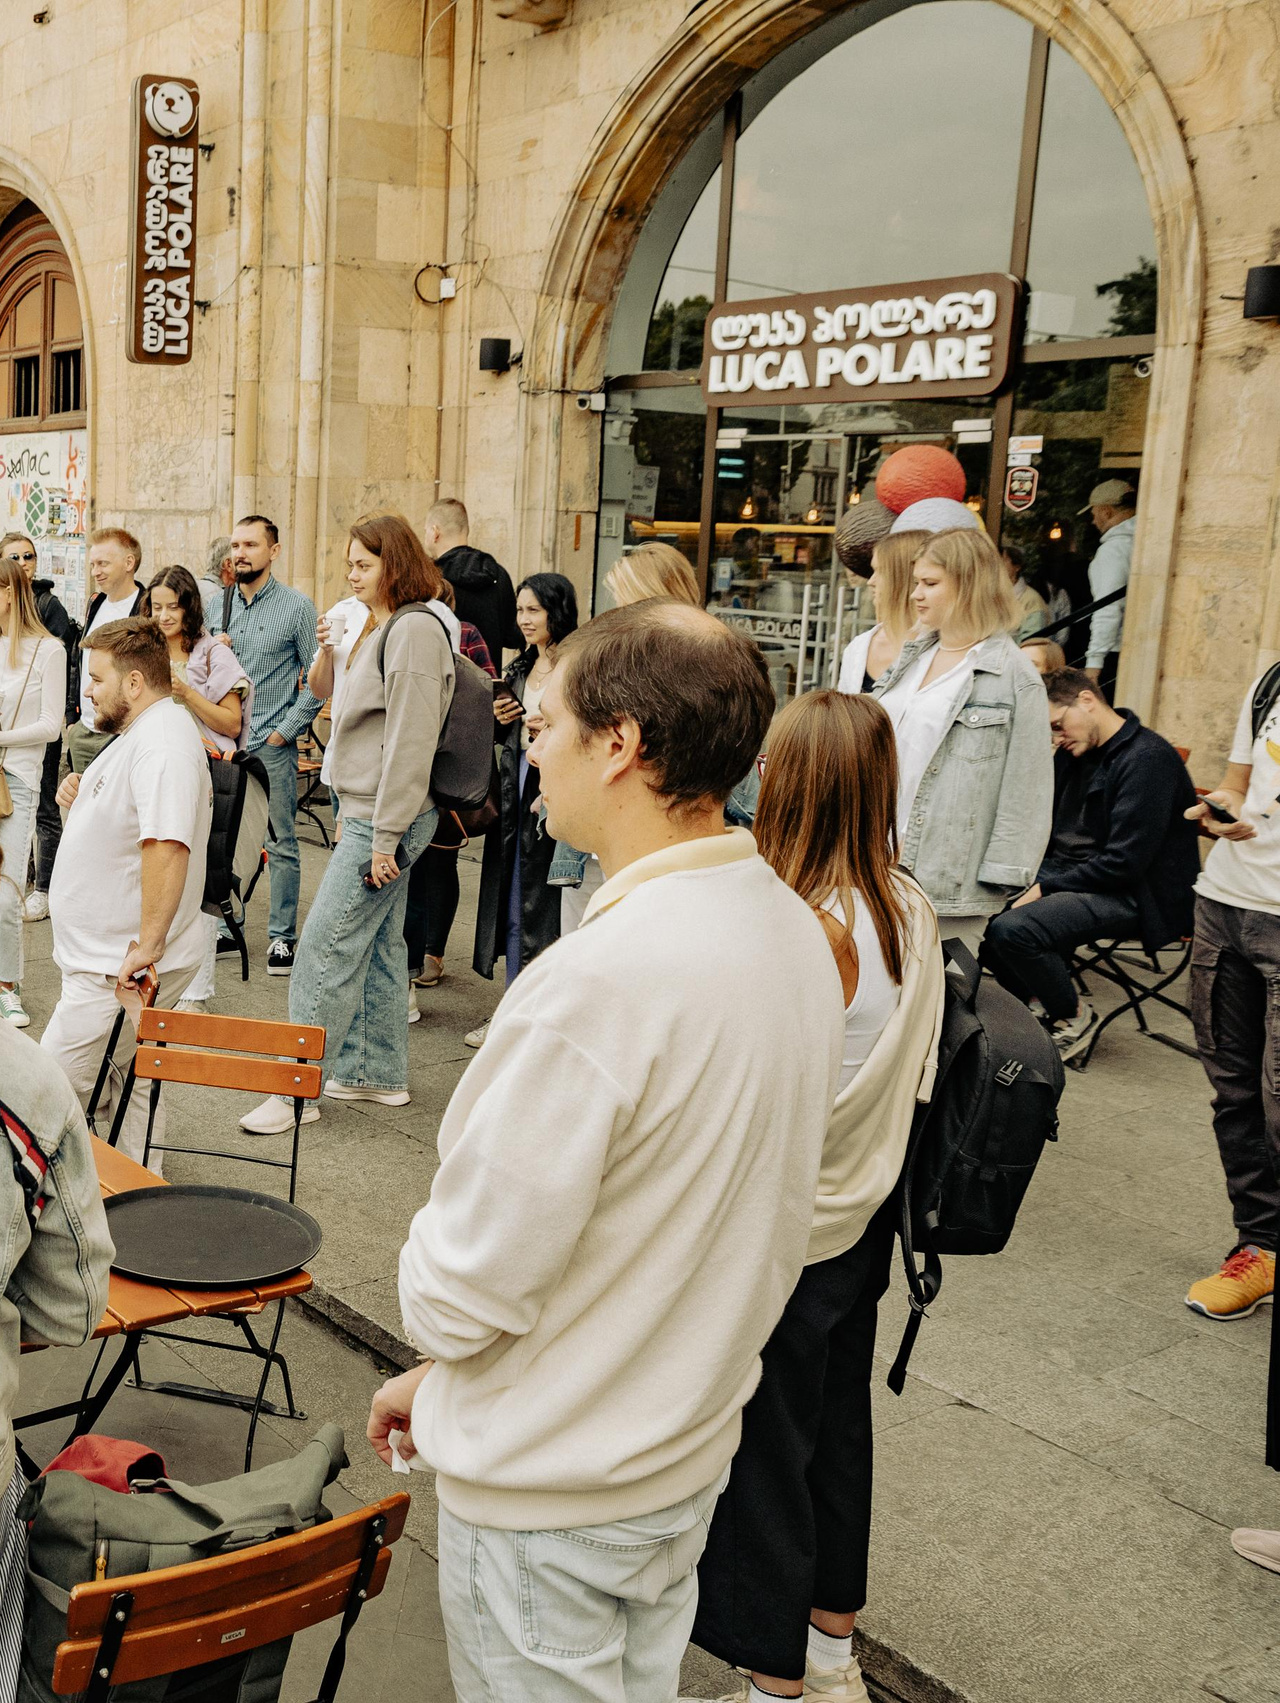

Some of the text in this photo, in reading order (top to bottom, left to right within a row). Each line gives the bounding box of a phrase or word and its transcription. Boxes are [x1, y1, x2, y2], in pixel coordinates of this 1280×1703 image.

[142, 144, 169, 353] ლუკა პოლარე
[165, 146, 194, 355] LUCA POLARE
[711, 288, 997, 350] ლუკა პოლარე
[708, 334, 993, 393] LUCA POLARE
[756, 620, 812, 638] POLAR
